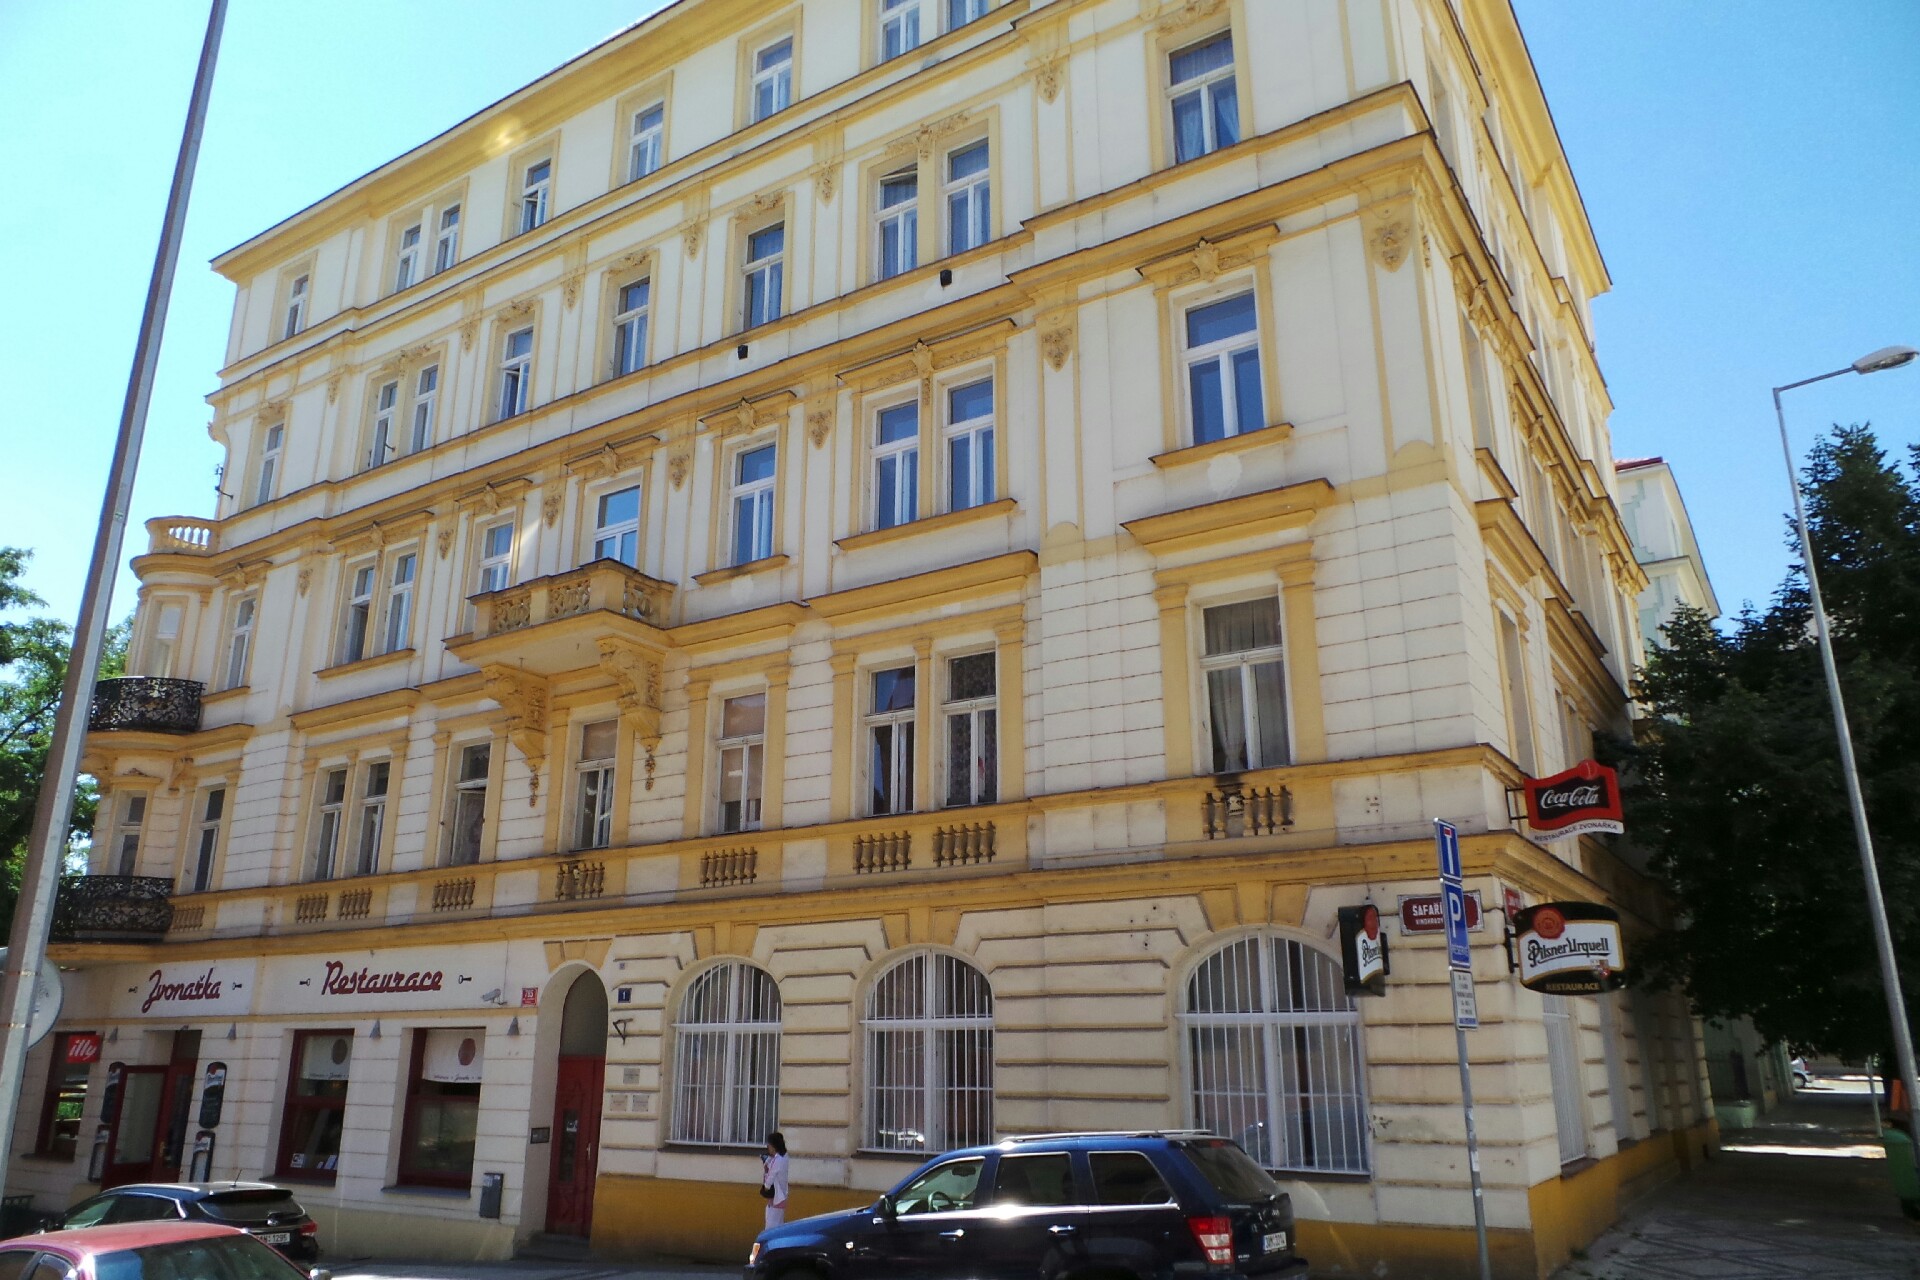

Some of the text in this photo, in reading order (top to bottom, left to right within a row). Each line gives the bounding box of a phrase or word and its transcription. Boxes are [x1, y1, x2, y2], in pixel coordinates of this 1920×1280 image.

[1541, 785, 1600, 809] Coca-Cola
[1534, 826, 1577, 841] RESTAURACE
[1448, 892, 1462, 939] P
[1528, 937, 1609, 968] Pilsner Urquell
[321, 960, 442, 995] Restaurace
[1546, 982, 1600, 991] RESTAURACE
[69, 1039, 97, 1061] illy
